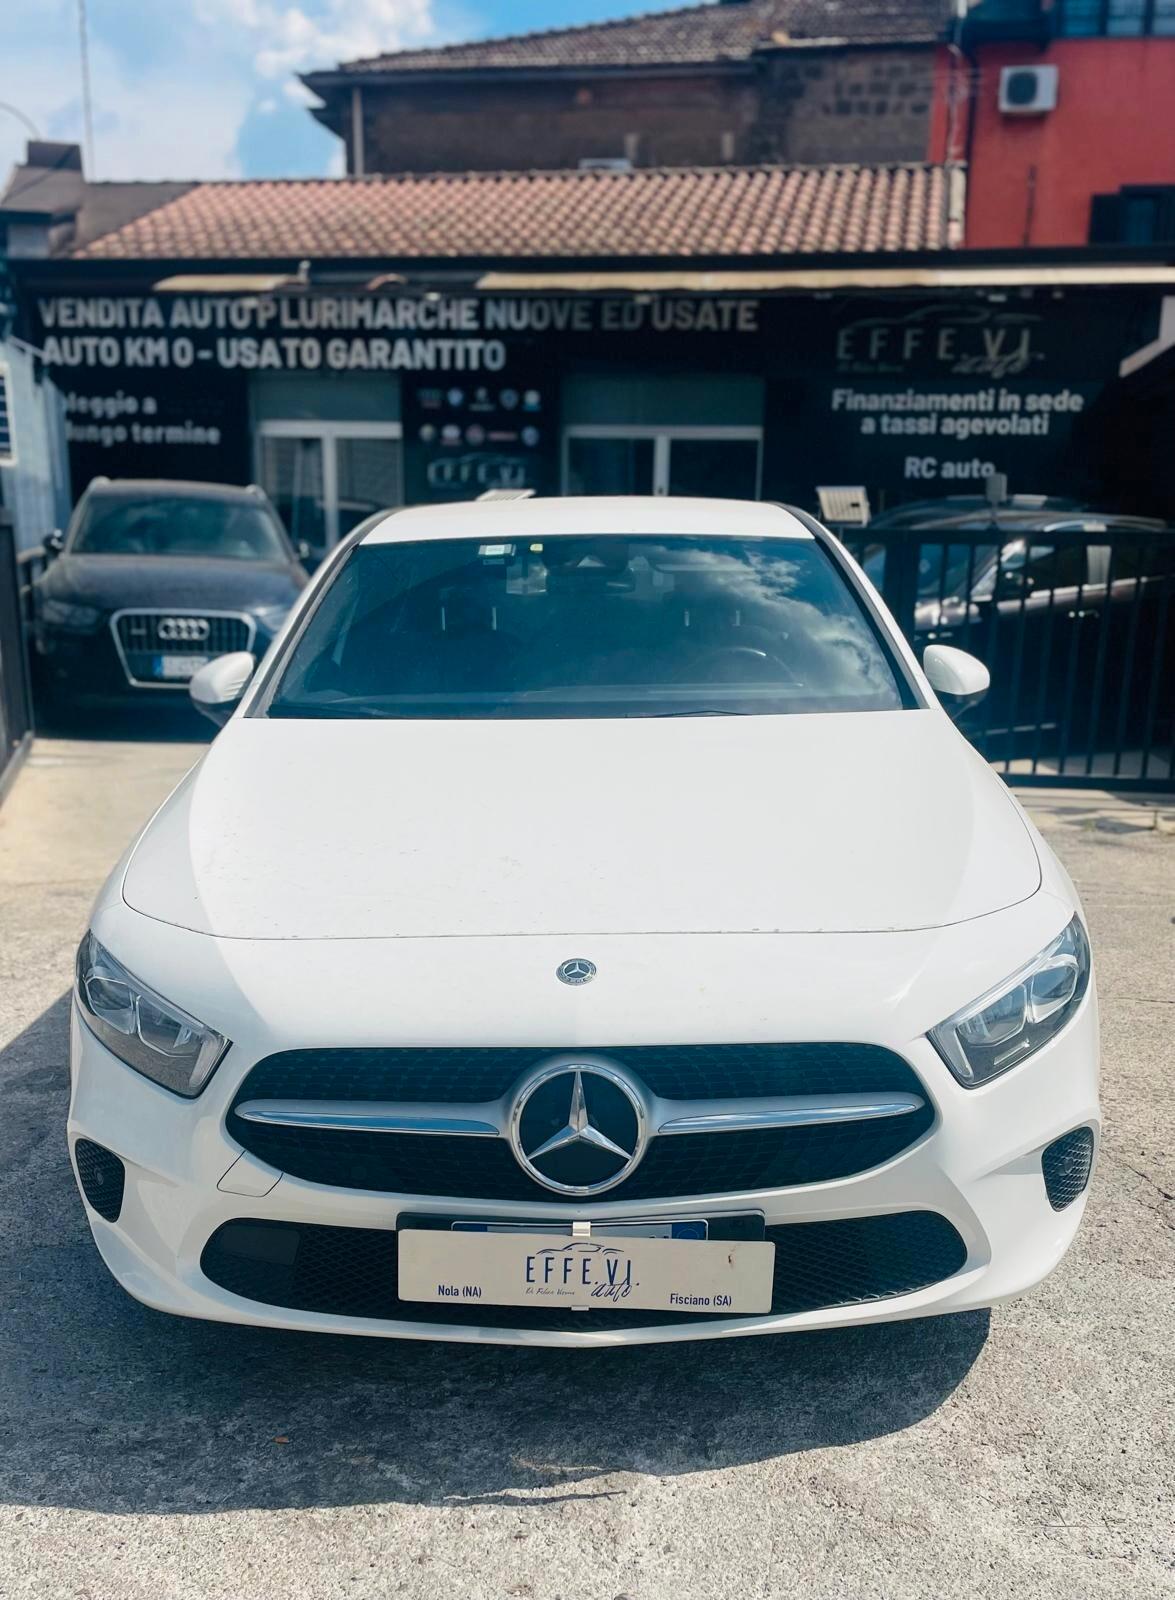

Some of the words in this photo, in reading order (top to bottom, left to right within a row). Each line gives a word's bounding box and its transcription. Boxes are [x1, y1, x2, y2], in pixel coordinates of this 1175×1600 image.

[38, 297, 164, 328] VENDITA
[170, 297, 253, 329] AUTO
[485, 299, 592, 331] NUOVE
[602, 300, 643, 331] ED
[652, 300, 759, 332] USATE
[41, 336, 121, 367] AUTO
[217, 338, 320, 369] USATO
[326, 338, 506, 370] GARANTITO
[66, 390, 139, 419] leggio
[142, 398, 157, 415] a
[831, 387, 995, 412] Finanziamenti
[999, 388, 1020, 411] in
[1024, 389, 1084, 413] sede
[131, 420, 220, 445] termine
[860, 415, 875, 435] a
[880, 413, 937, 435] tassi
[940, 412, 1050, 441] agevolati
[904, 456, 936, 480] RC
[940, 458, 996, 480] auto
[437, 1284, 460, 1298] Nola
[462, 1284, 483, 1299] (NA)
[669, 1292, 711, 1307] Fisciano
[713, 1295, 733, 1308] (SA)
